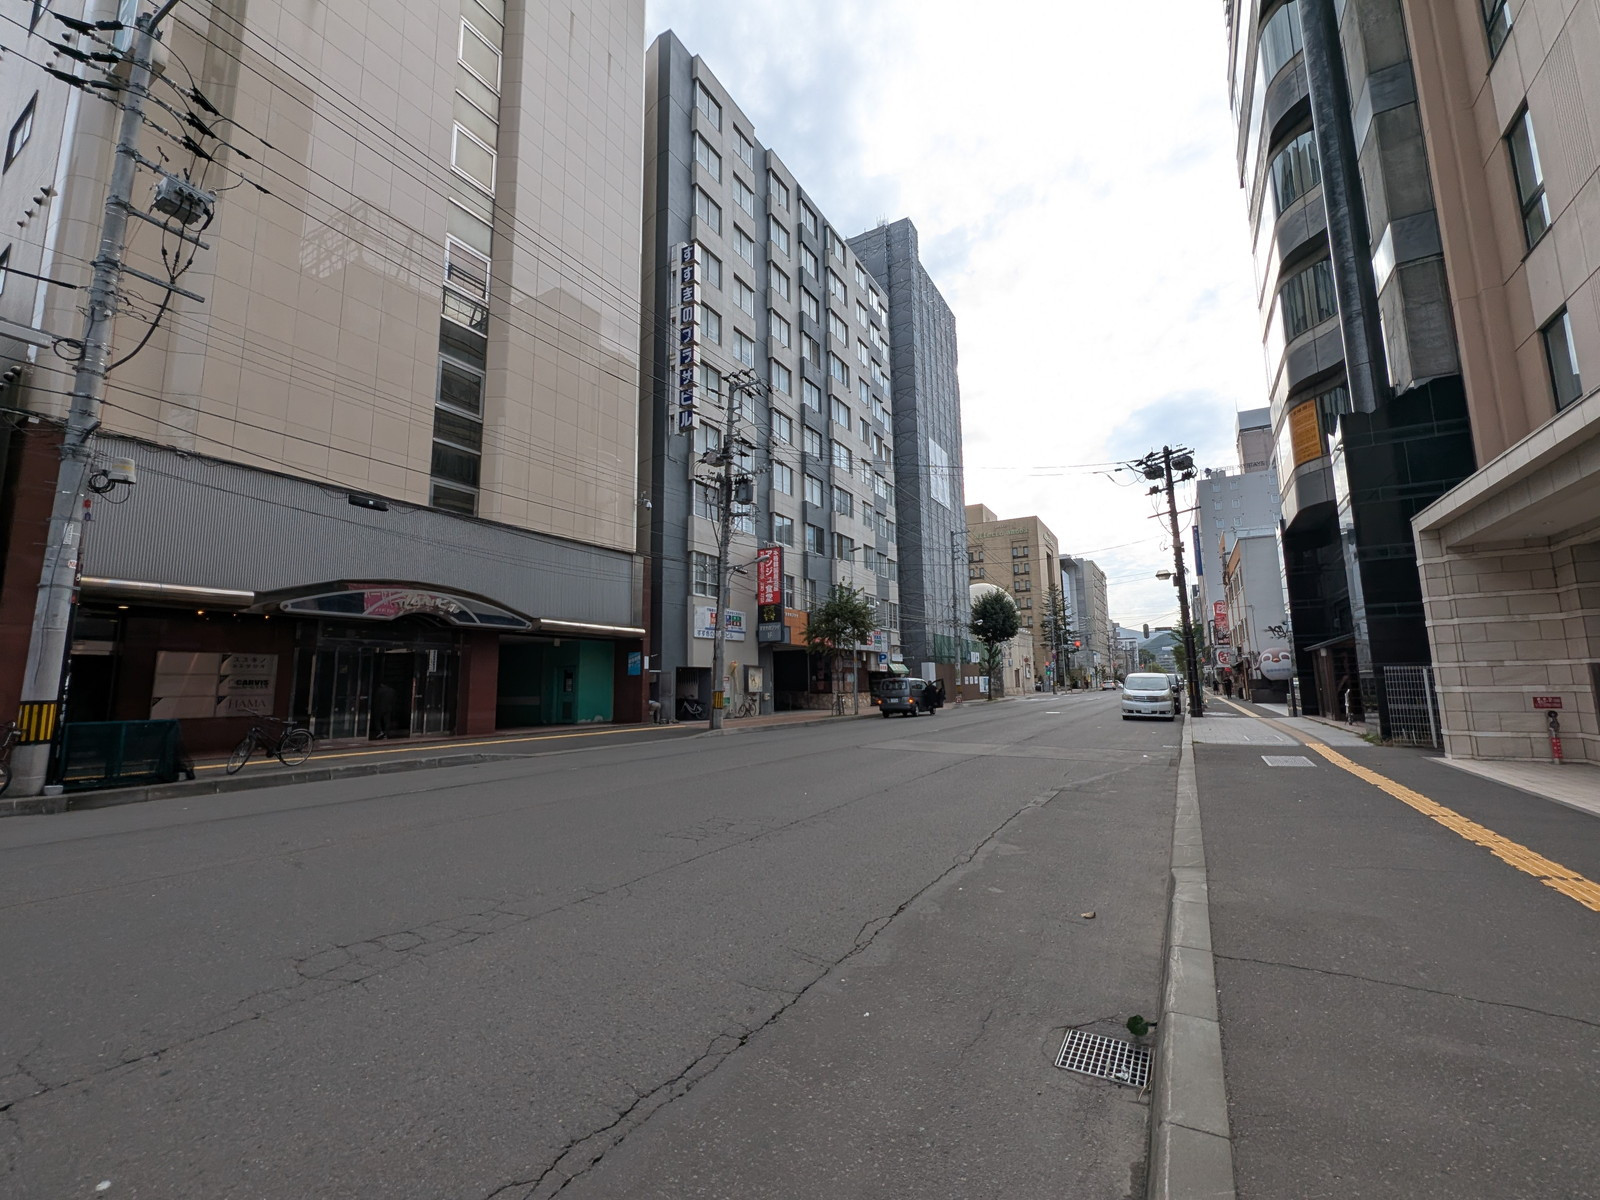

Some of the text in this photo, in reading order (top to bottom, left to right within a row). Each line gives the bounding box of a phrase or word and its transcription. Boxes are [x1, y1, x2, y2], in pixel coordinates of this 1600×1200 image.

[680, 247, 693, 428] すすきのプラザビル
[879, 653, 887, 662] P
